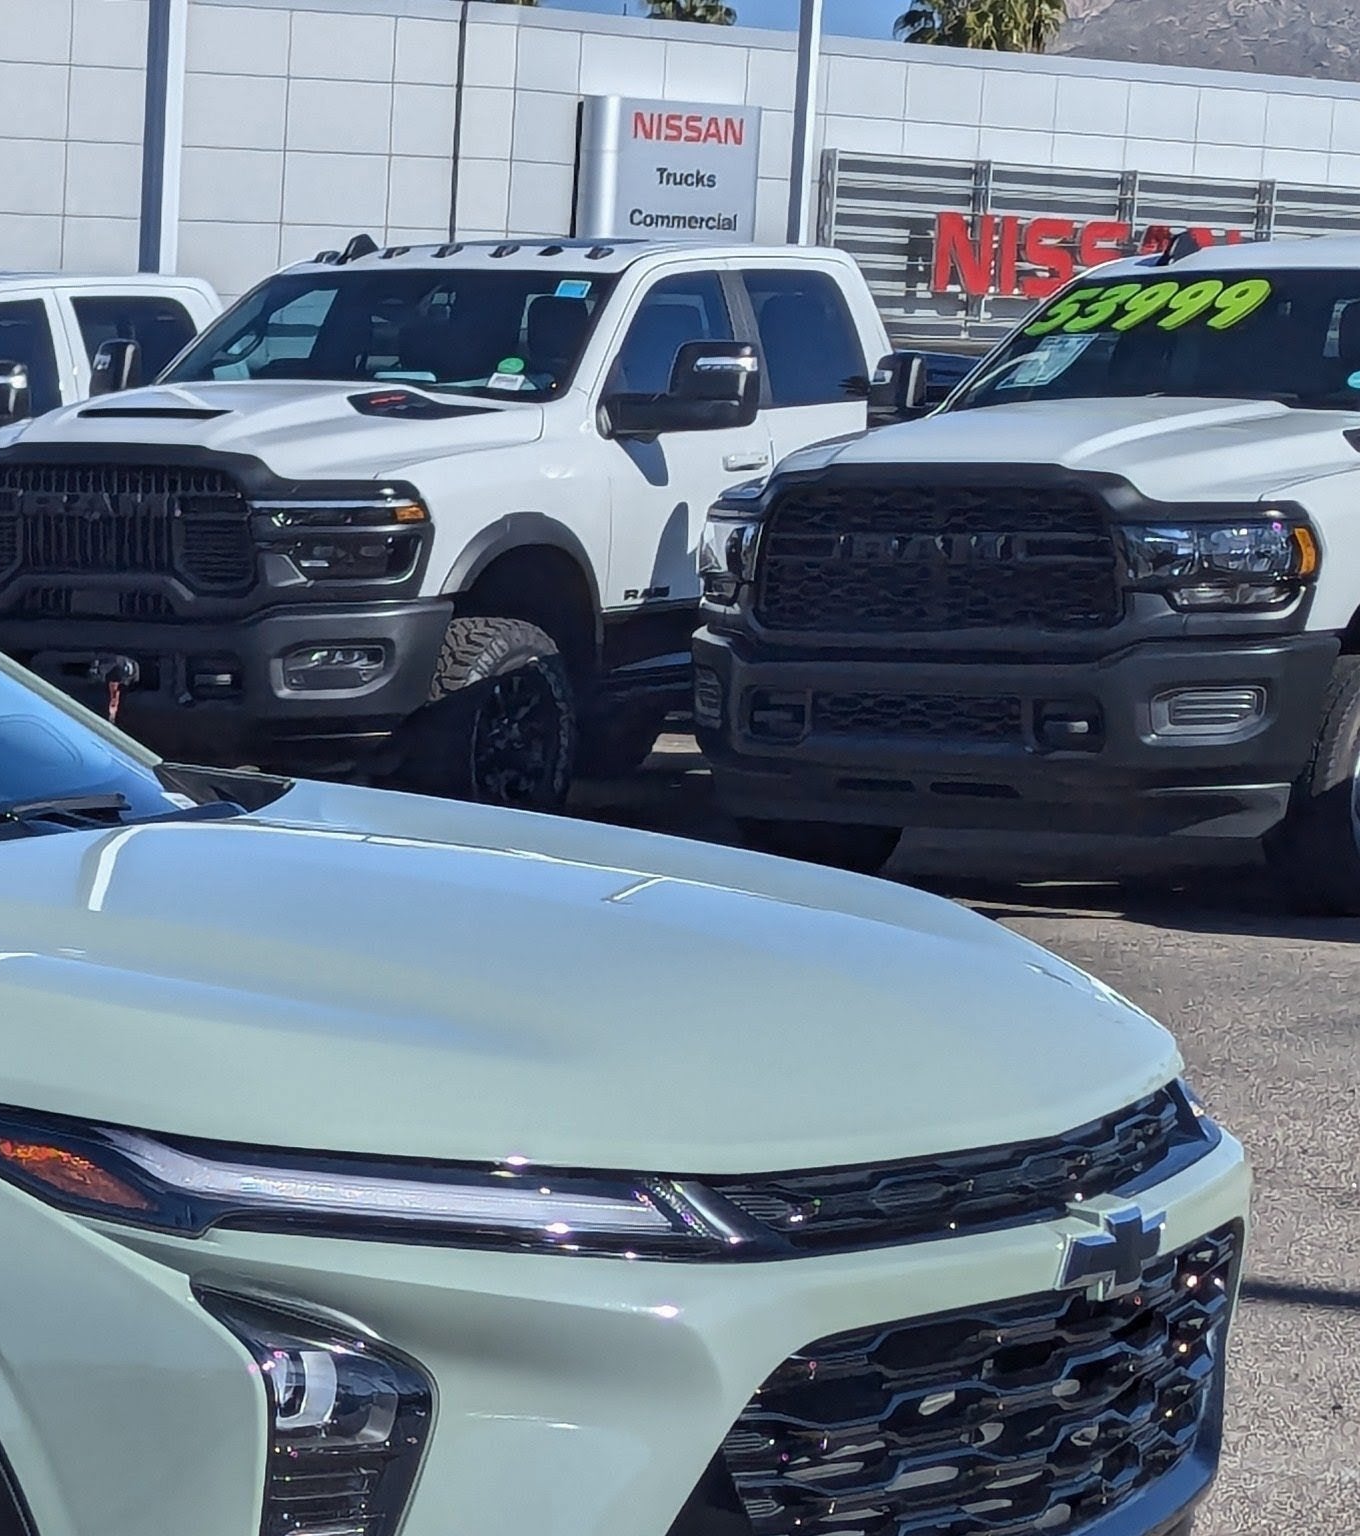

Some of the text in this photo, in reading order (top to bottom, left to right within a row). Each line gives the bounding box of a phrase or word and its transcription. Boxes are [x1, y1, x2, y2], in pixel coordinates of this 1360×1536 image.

[632, 111, 744, 146] NISSAN
[656, 167, 717, 189] Trucks
[629, 208, 738, 232] Commercial
[931, 211, 1242, 299] NISS
[1024, 279, 1272, 337] 53999
